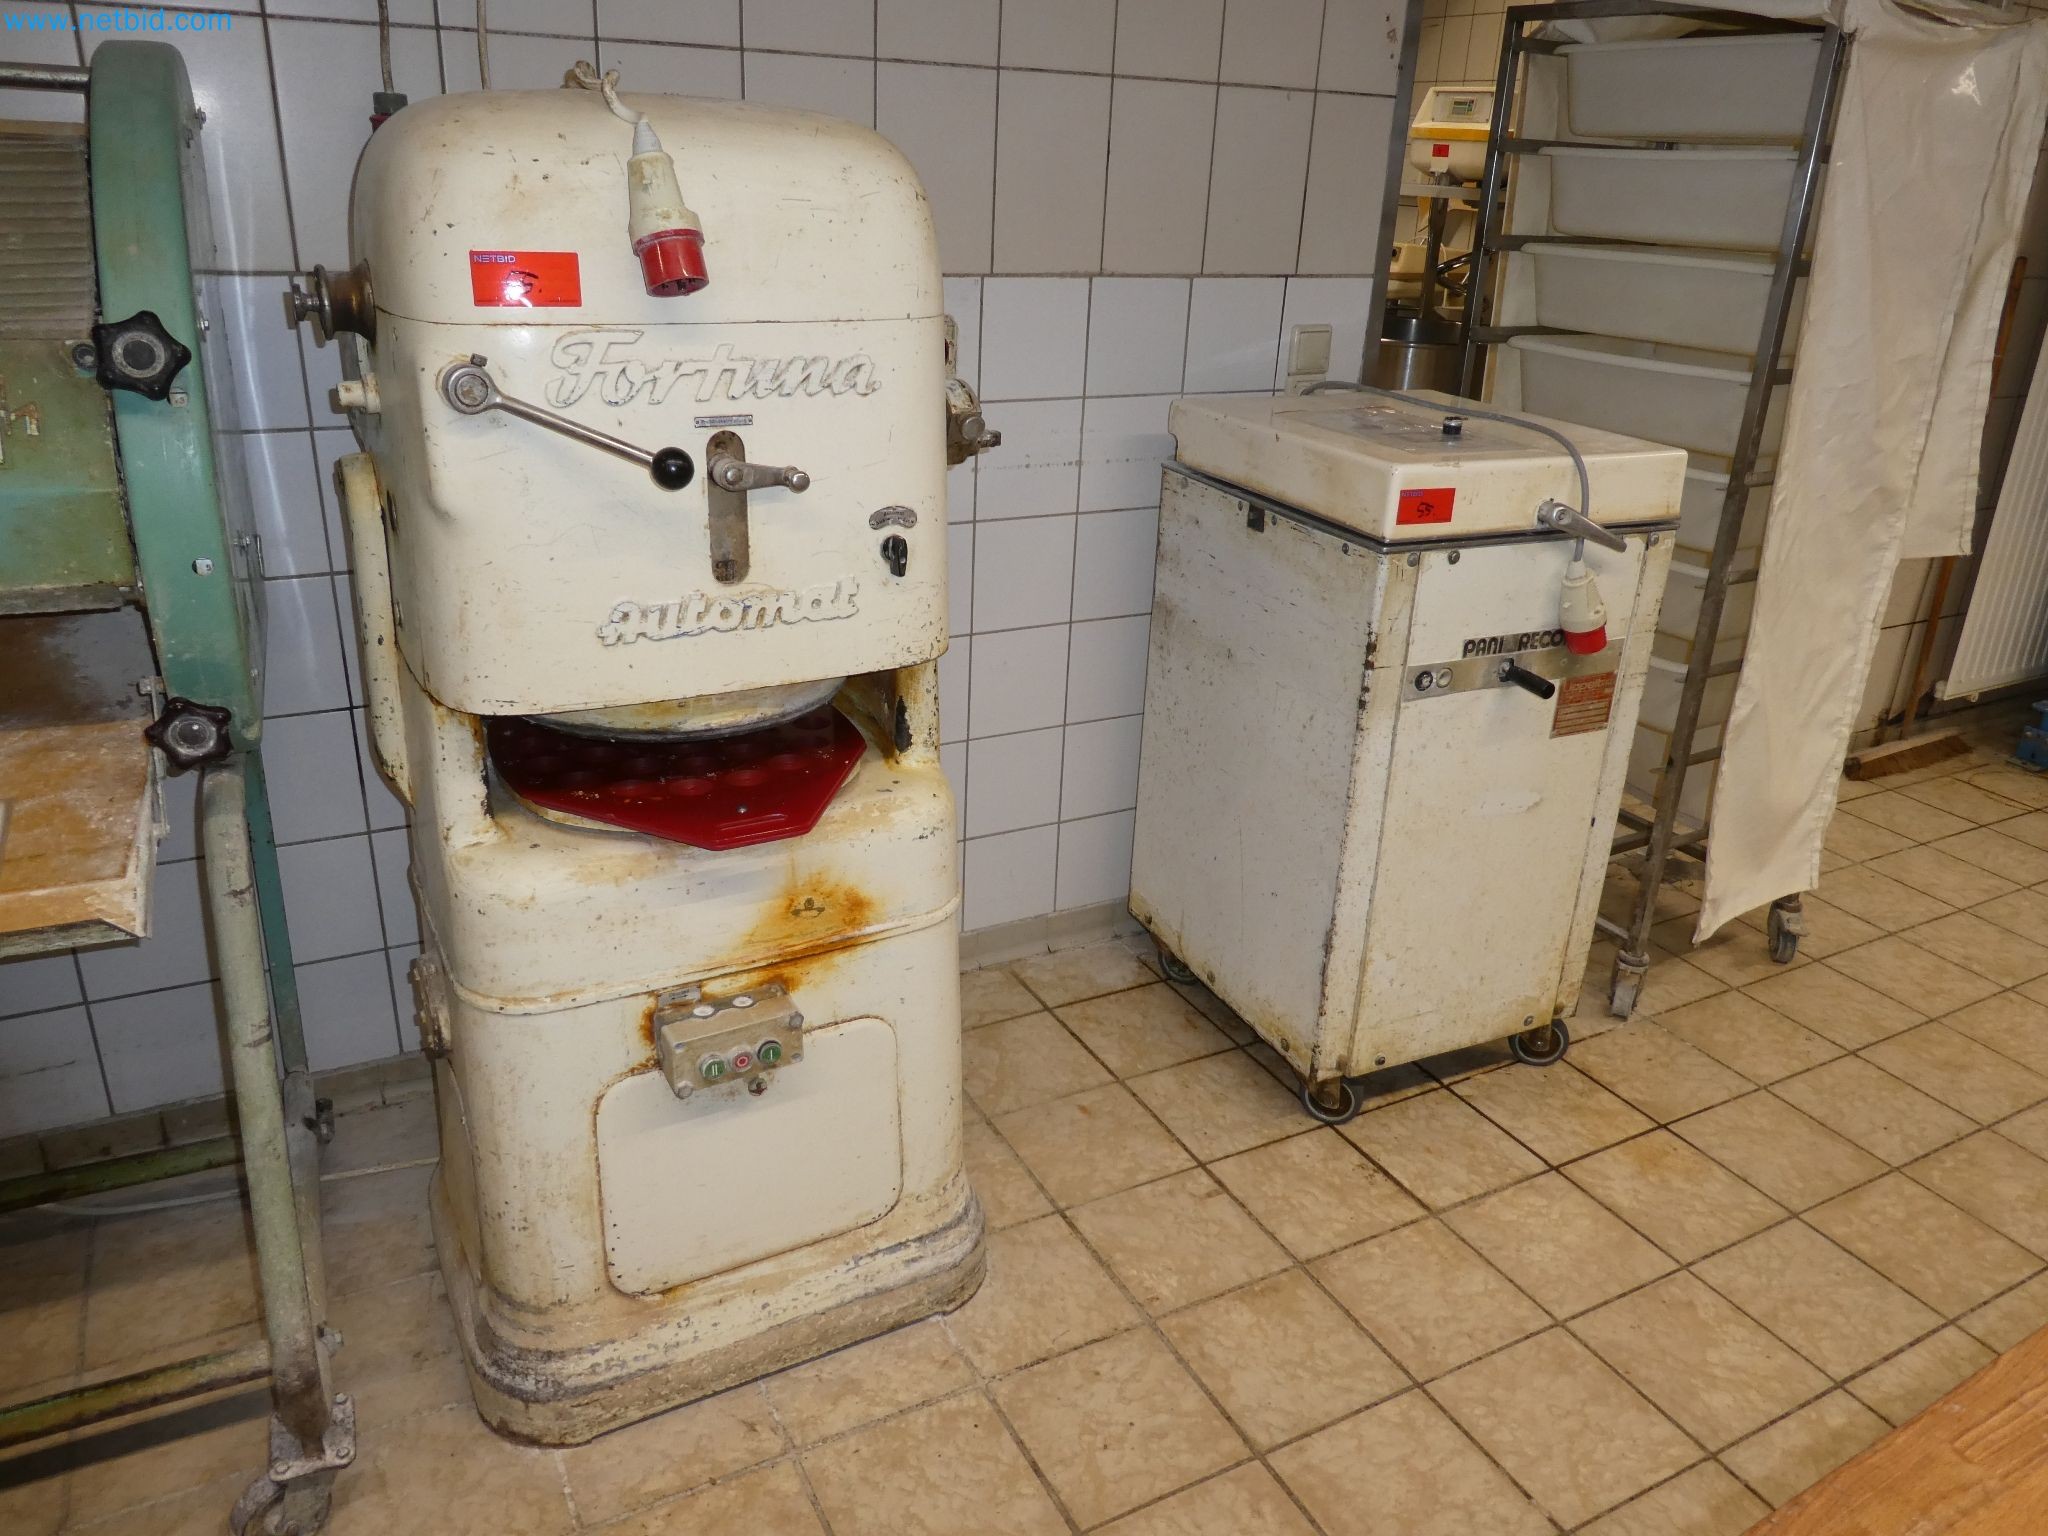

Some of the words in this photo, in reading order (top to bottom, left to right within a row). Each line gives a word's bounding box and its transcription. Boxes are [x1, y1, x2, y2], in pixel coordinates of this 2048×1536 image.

[474, 255, 516, 263] NETBID
[545, 329, 883, 408] Fortuna
[1518, 629, 1567, 651] RECO
